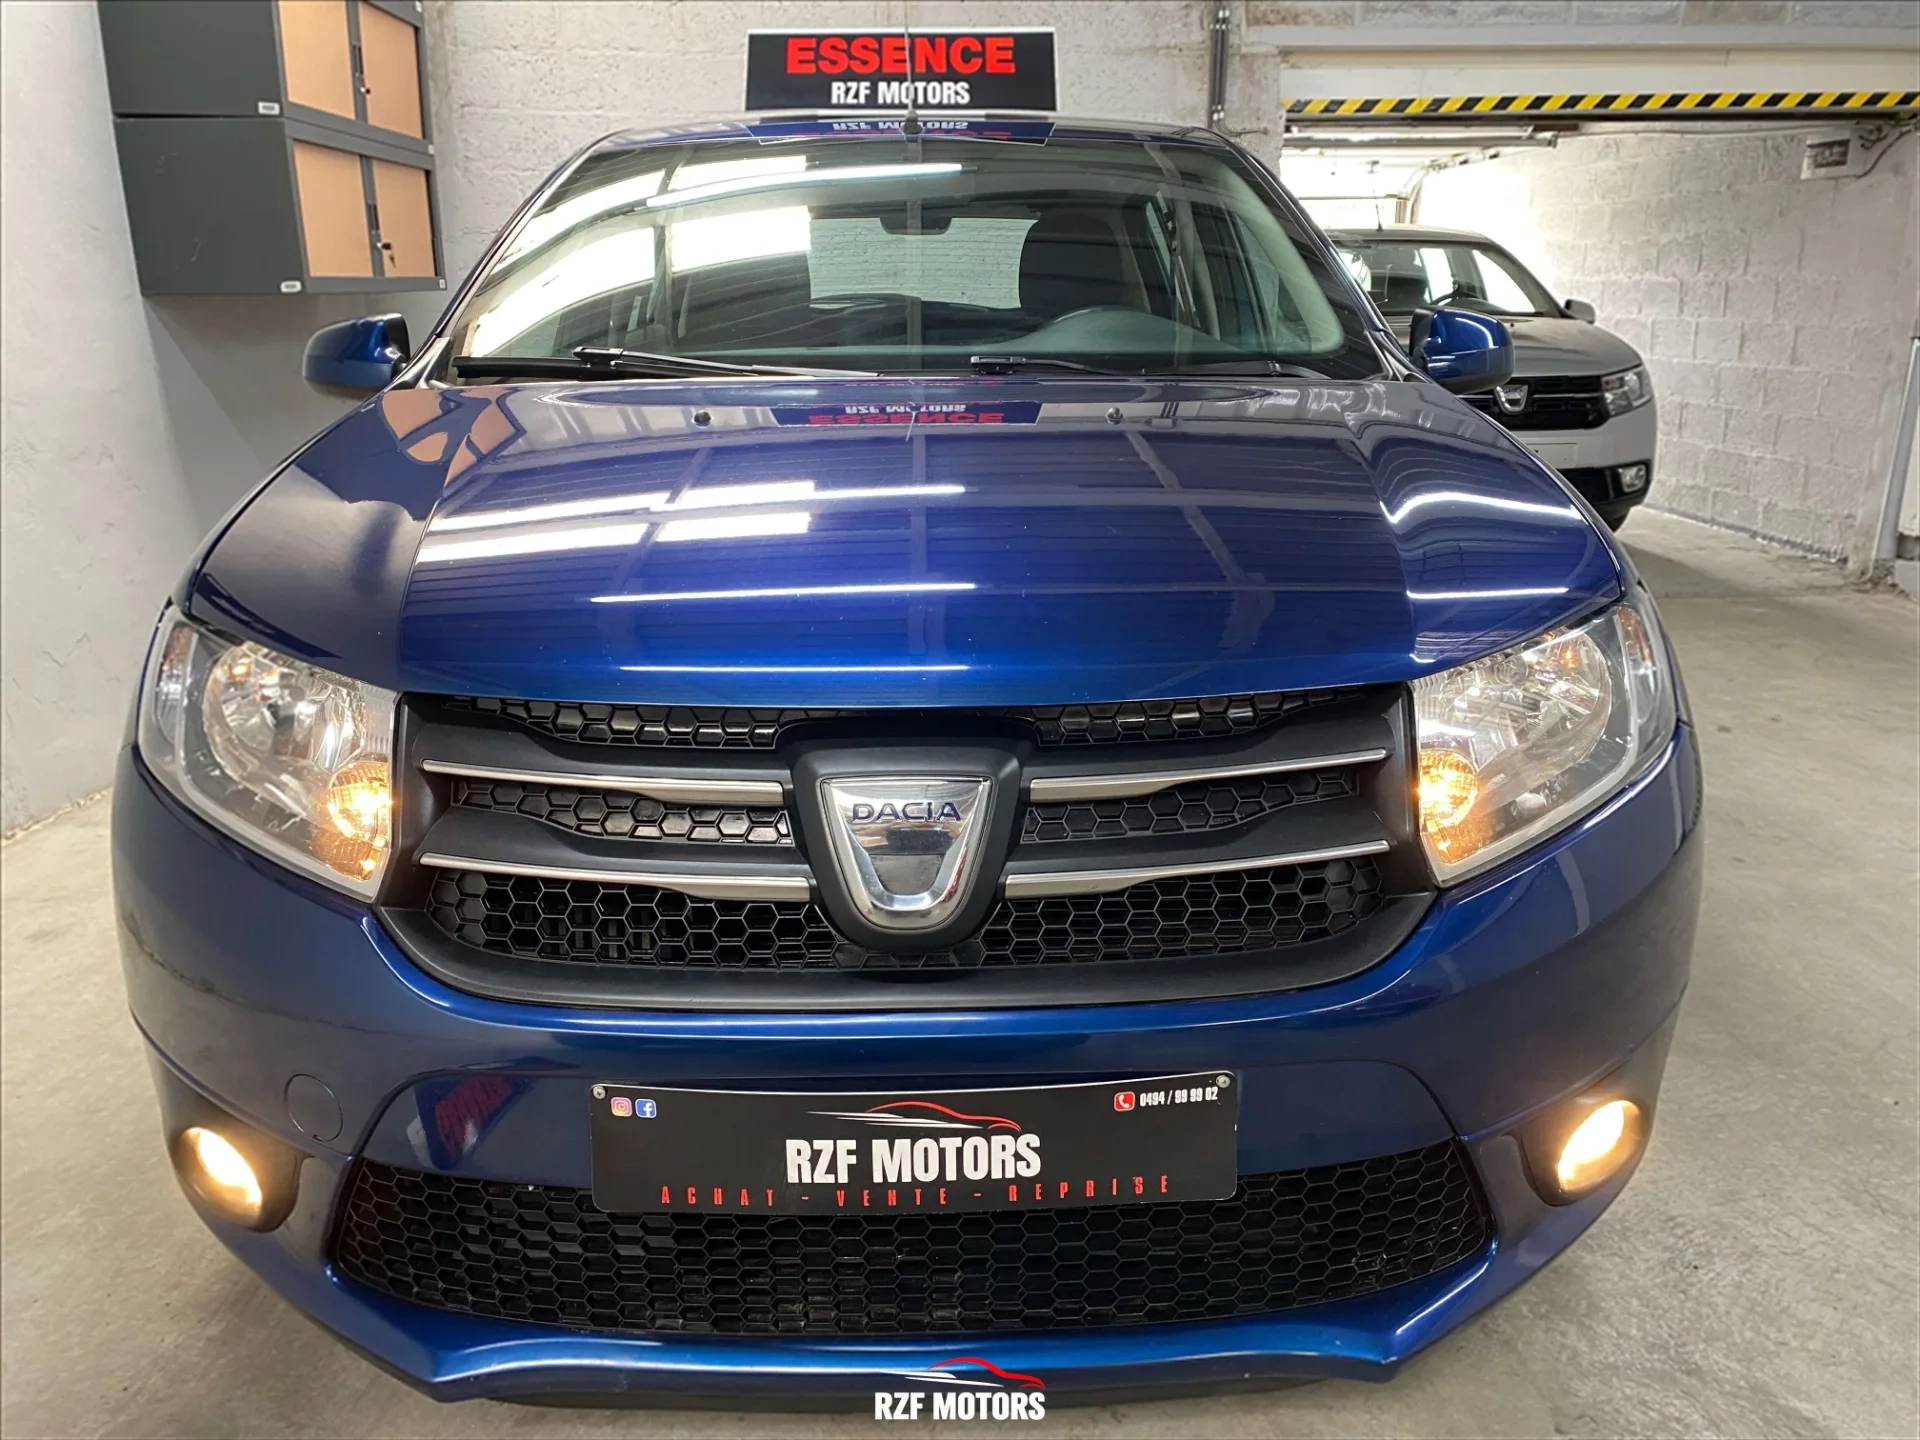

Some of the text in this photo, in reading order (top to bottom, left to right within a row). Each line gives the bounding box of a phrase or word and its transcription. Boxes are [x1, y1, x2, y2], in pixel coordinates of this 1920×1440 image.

[786, 36, 1016, 75] ESSENCE
[831, 81, 970, 106] RZF MOTORS
[852, 802, 962, 822] DACIA
[1140, 1091, 1165, 1107] 0494
[1174, 1089, 1188, 1104] 99
[1190, 1087, 1203, 1102] 99
[1205, 1086, 1219, 1101] 02
[786, 1134, 1041, 1184] RZF MOTORS
[661, 1185, 774, 1207] ACHAT
[836, 1187, 947, 1207] VENTE
[1008, 1175, 1168, 1203] REPRISE
